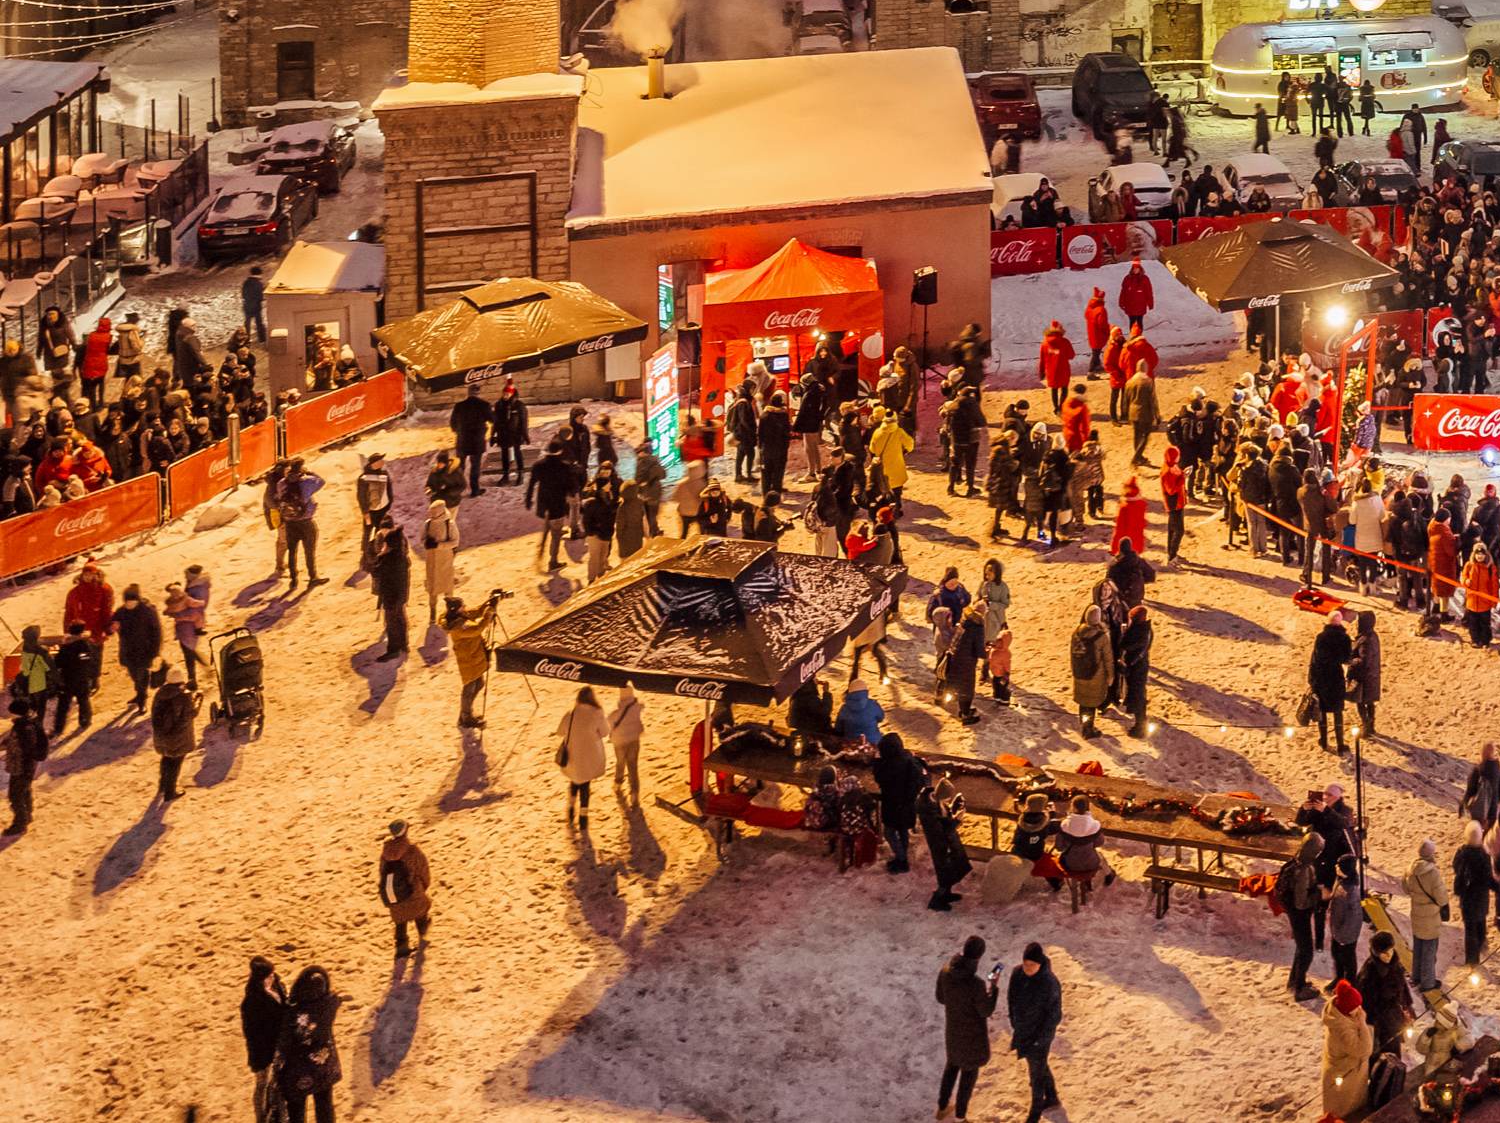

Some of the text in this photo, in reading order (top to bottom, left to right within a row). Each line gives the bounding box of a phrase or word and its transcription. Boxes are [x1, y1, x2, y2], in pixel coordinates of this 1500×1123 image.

[764, 307, 824, 330] Coca-Cola
[577, 335, 615, 354] Coca-Cola
[464, 362, 503, 384] Coca-Cola
[534, 658, 584, 681] Coca-Cola
[674, 677, 728, 700] Coca-Cola
